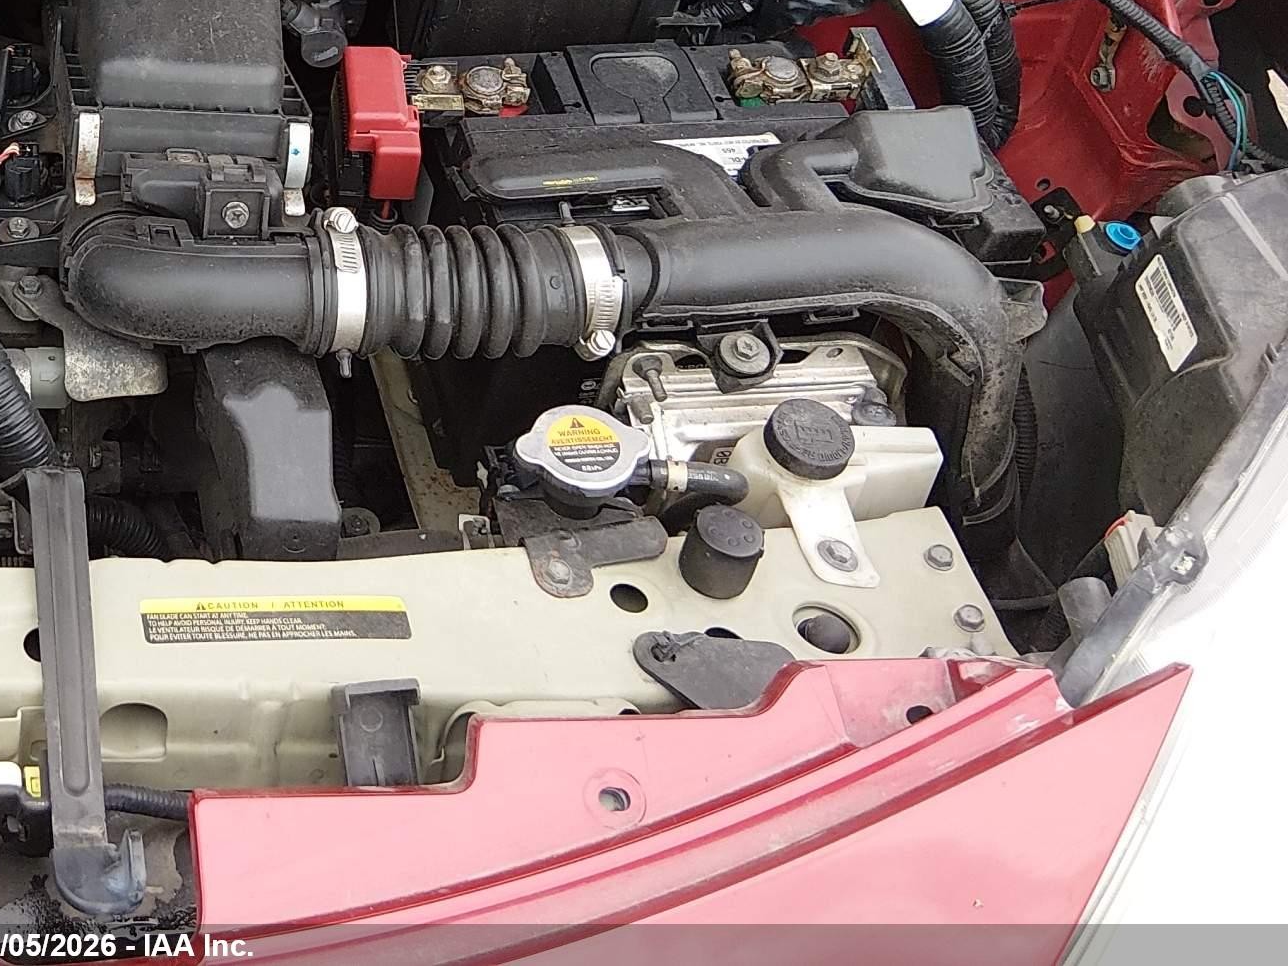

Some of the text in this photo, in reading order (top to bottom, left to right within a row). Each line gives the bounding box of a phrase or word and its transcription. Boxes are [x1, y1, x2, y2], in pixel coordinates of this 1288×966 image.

[557, 428, 601, 436] WARNING
[551, 435, 613, 444] AVERTISSEMENT
[207, 602, 258, 610] CAUTION
[283, 600, 344, 609] ATTENTION
